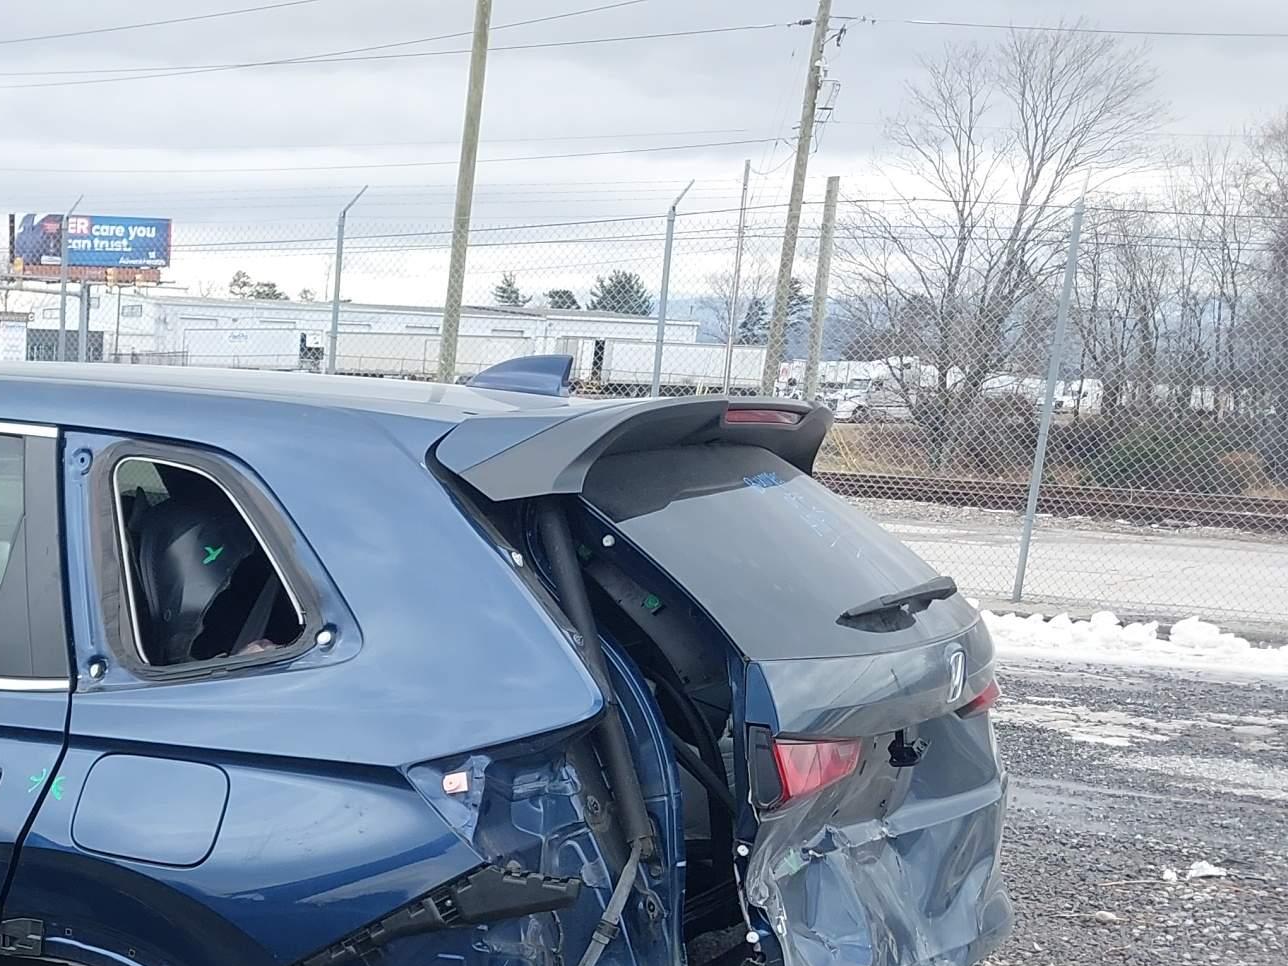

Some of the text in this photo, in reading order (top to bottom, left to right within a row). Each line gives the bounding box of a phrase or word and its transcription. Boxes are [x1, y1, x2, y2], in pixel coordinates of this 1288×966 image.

[68, 217, 156, 241] ER care you
[93, 237, 132, 252] trust.
